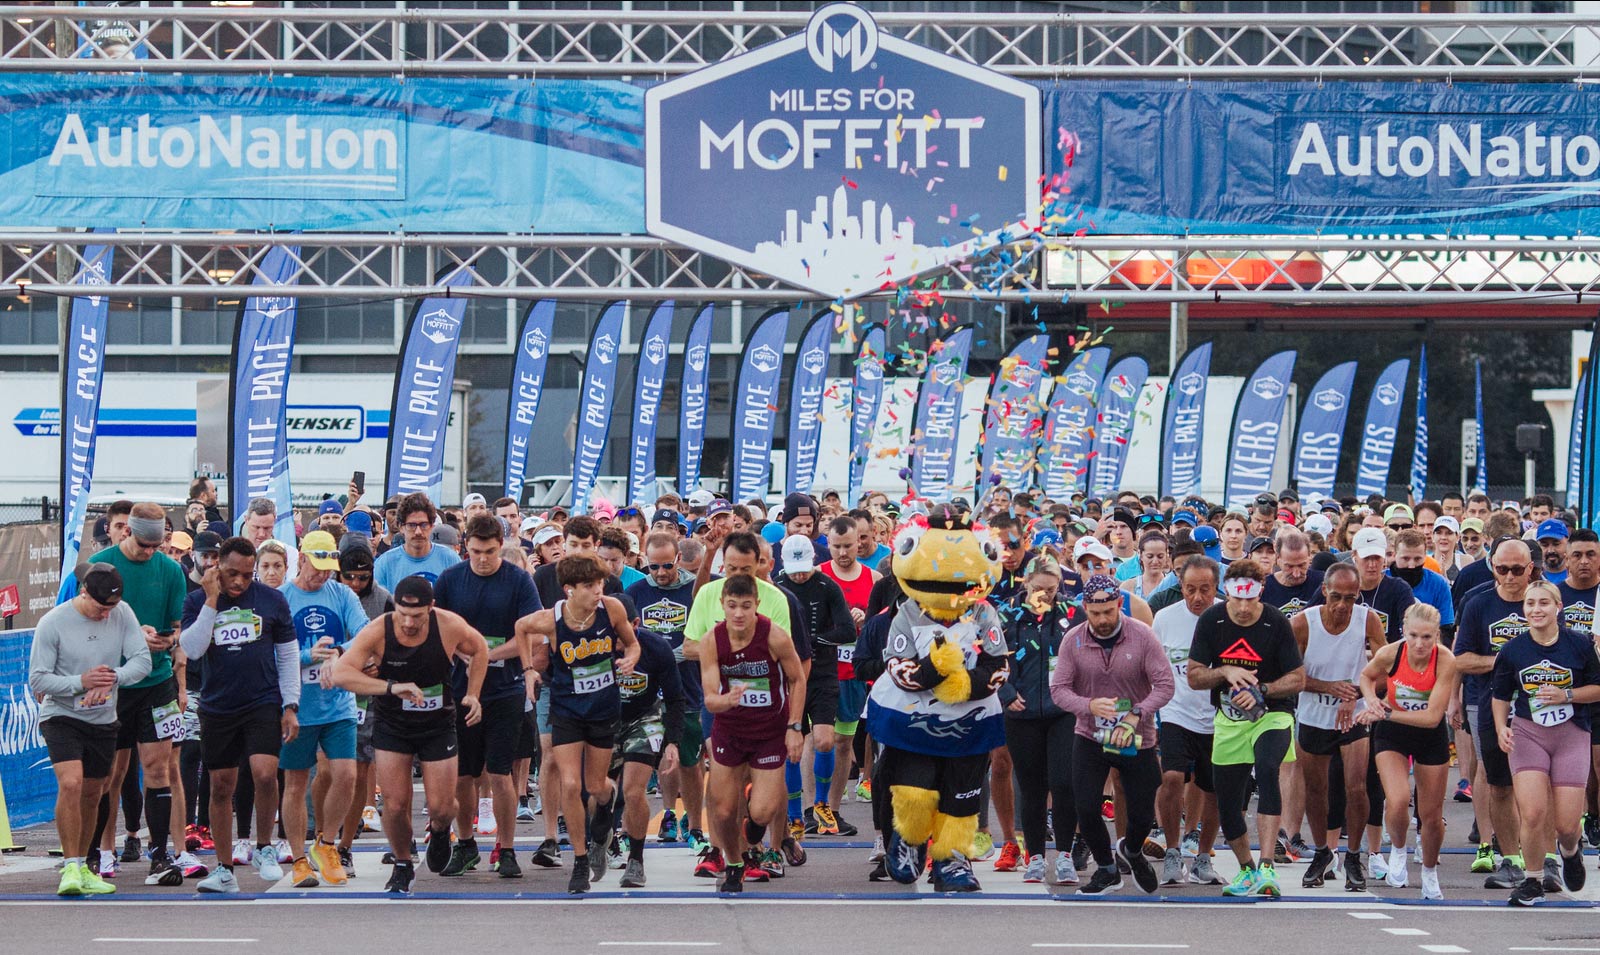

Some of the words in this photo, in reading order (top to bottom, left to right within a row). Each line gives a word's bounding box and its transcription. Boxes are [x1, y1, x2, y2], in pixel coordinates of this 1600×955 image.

[770, 88, 851, 111] MILES
[860, 88, 914, 110] FOR
[48, 113, 397, 169] AutoNation
[699, 118, 985, 170] MOFFITT
[250, 335, 290, 400] PACE
[408, 357, 444, 416] PACE
[515, 371, 540, 425] PACE
[585, 374, 607, 428] PACE
[640, 376, 662, 425] PACE
[743, 383, 773, 430] PACE
[798, 386, 822, 430] PACE
[1174, 404, 1201, 444] PACE
[288, 444, 312, 456] Truck
[315, 444, 346, 456] Rental
[1296, 431, 1340, 489] KERS
[647, 610, 680, 619] MOFFITT
[220, 627, 249, 641] 204
[1239, 659, 1259, 667] TRAIL
[1525, 674, 1565, 683] MOFFITT
[578, 674, 611, 690] 1214
[743, 693, 768, 705] 185
[162, 717, 181, 734] 350
[1540, 708, 1567, 725] 715
[955, 788, 982, 799] CCM
